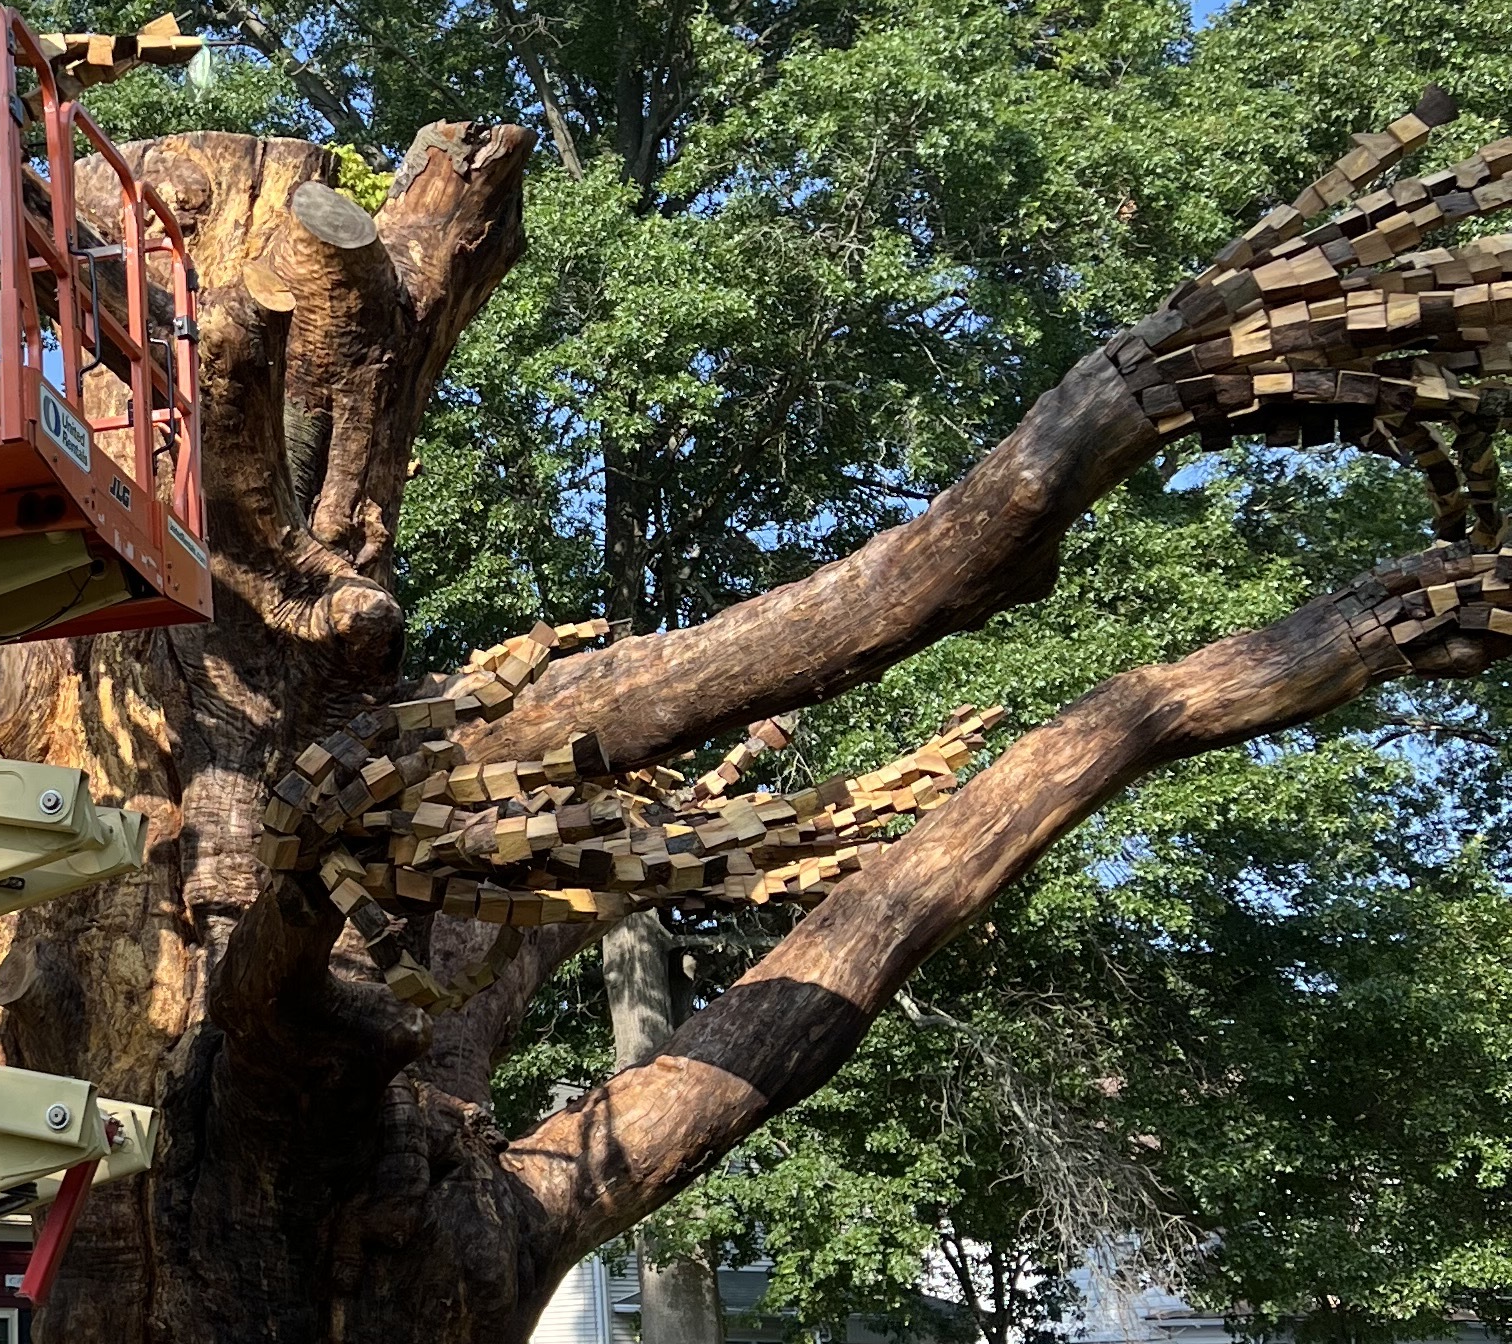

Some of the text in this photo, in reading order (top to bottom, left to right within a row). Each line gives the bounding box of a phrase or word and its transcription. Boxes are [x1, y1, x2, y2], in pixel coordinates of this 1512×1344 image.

[61, 412, 86, 447] United
[62, 429, 88, 466] Rentals
[109, 475, 130, 508] JLG
